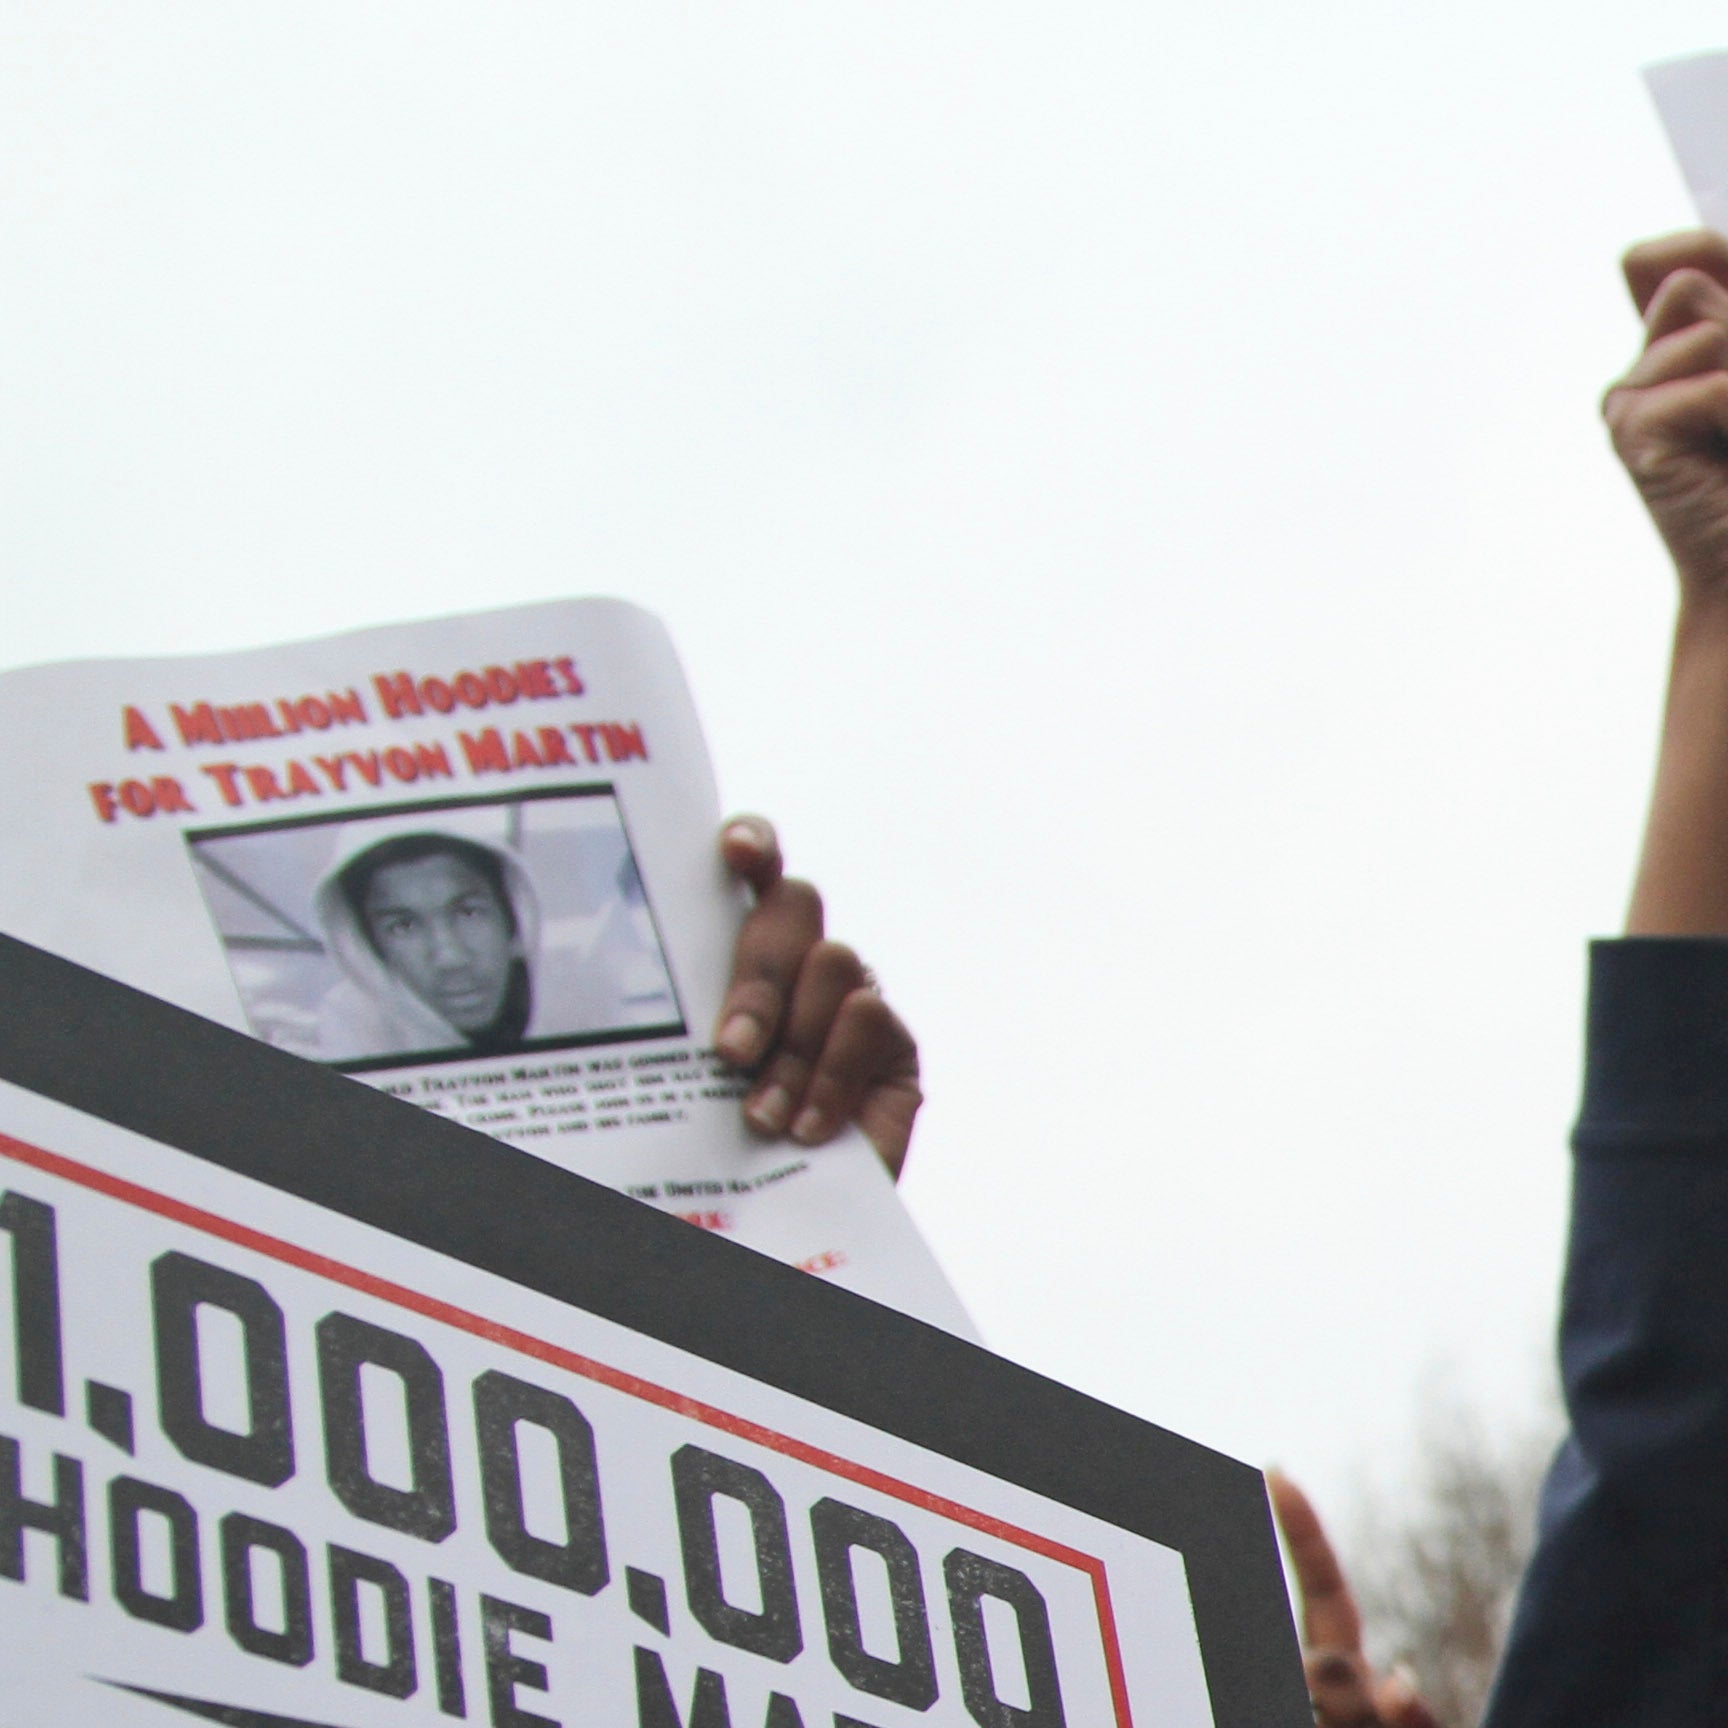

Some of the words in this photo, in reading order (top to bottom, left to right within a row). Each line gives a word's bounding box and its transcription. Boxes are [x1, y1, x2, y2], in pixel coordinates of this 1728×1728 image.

[122, 706, 163, 752] A
[372, 655, 585, 721] HOODIES
[88, 775, 195, 824] FOR
[201, 741, 454, 806] TRAYVON
[456, 720, 650, 776] MARTIN
